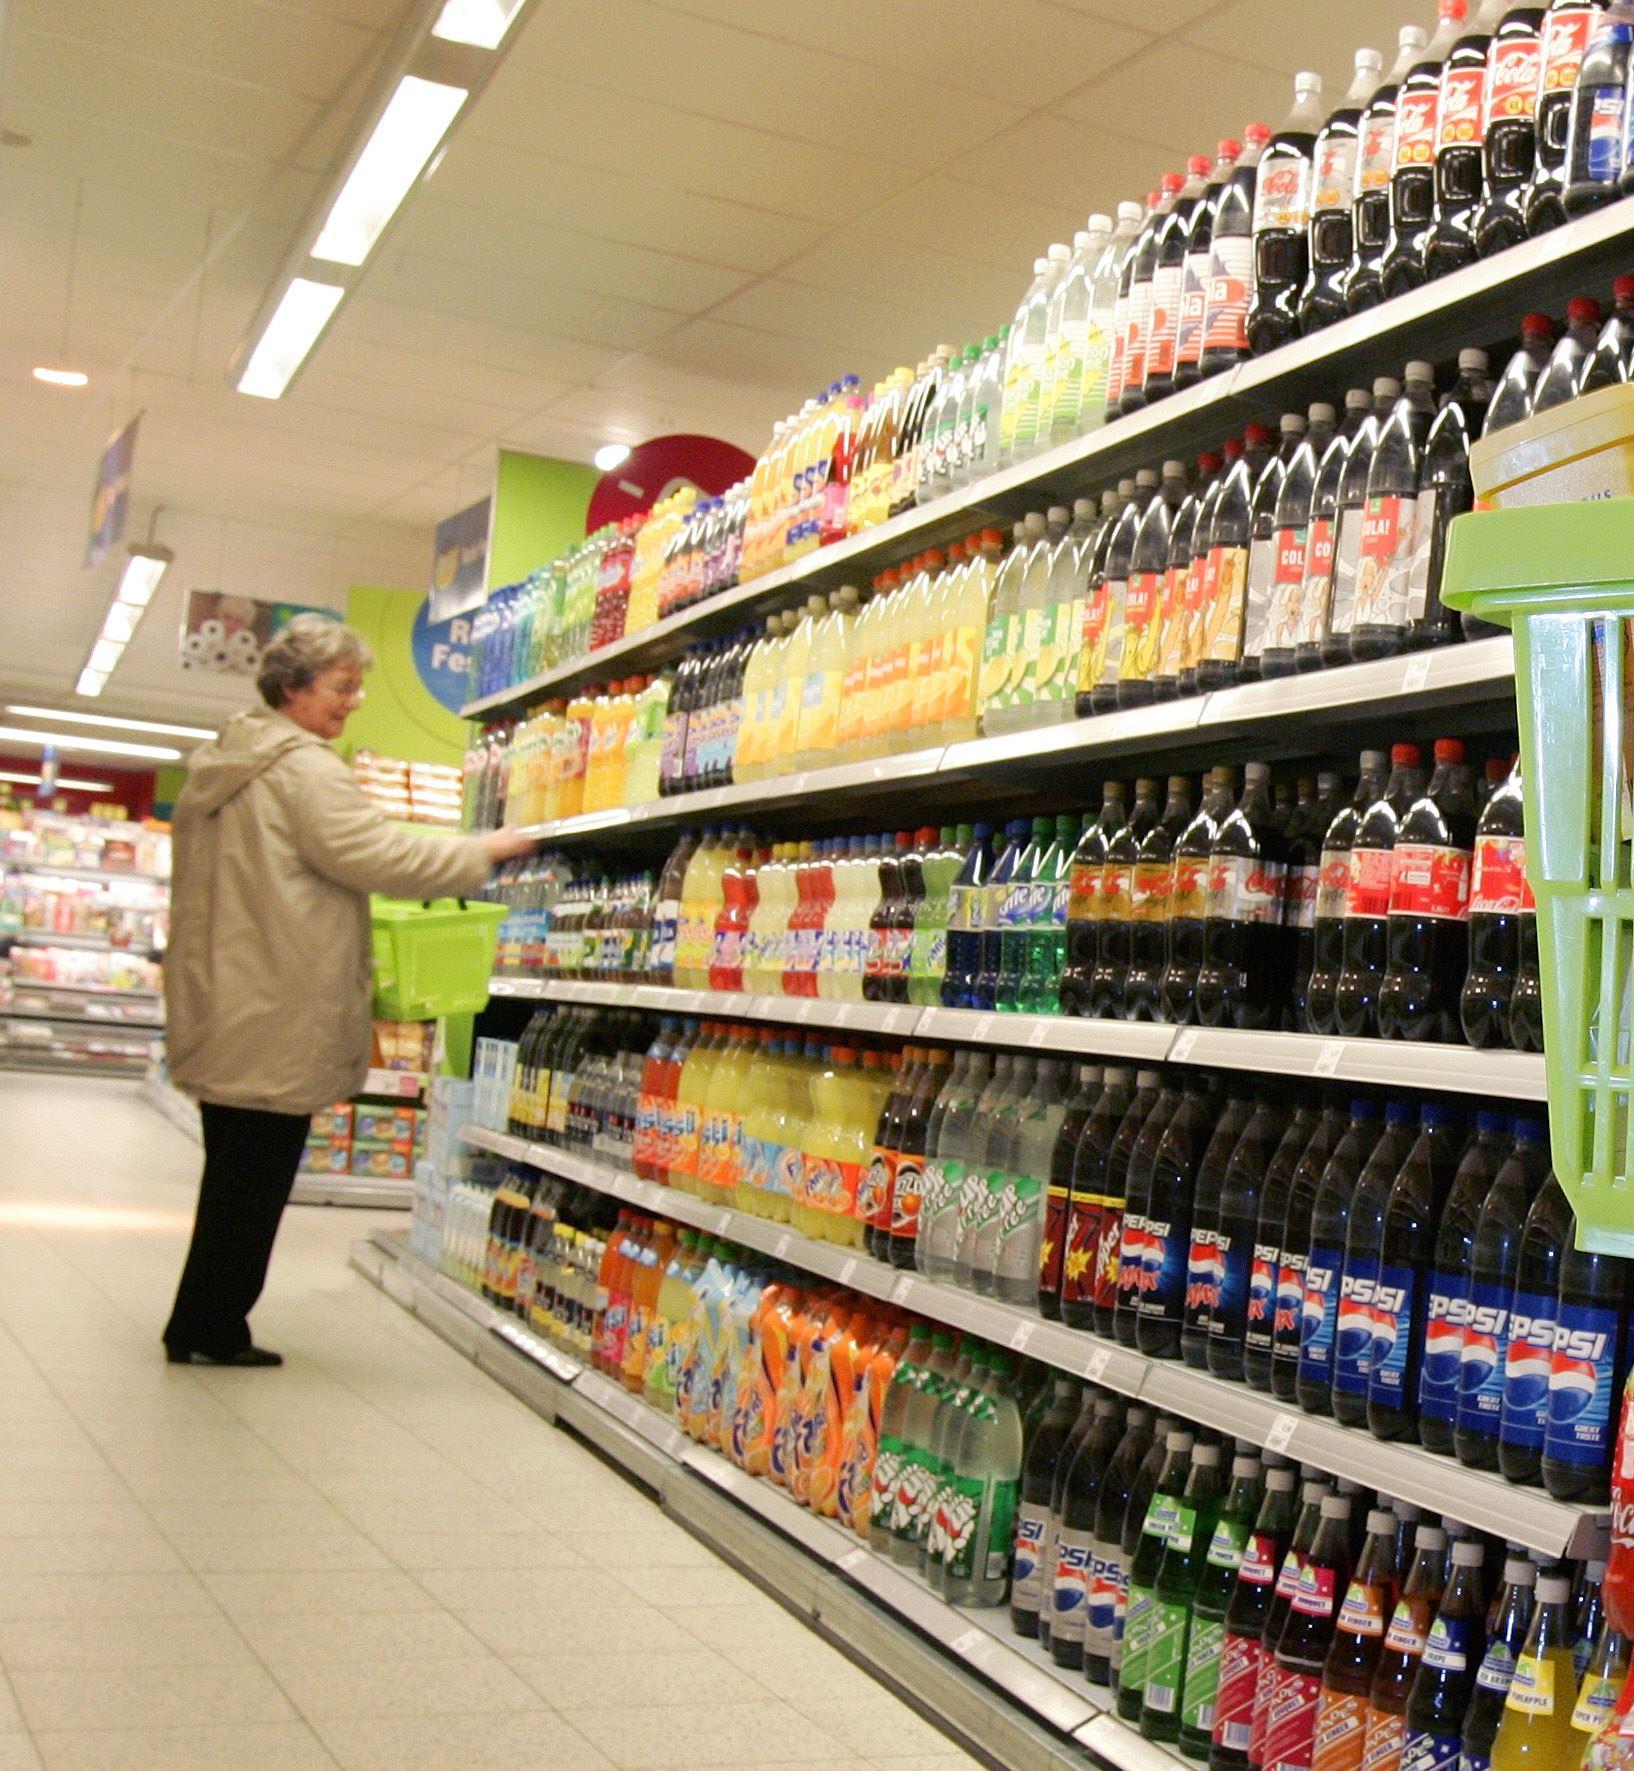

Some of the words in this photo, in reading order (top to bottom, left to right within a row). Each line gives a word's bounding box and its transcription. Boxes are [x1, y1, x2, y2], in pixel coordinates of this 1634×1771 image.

[1594, 97, 1624, 116] SI
[1306, 1266, 1333, 1292] SI
[1553, 1325, 1608, 1361] PSI
